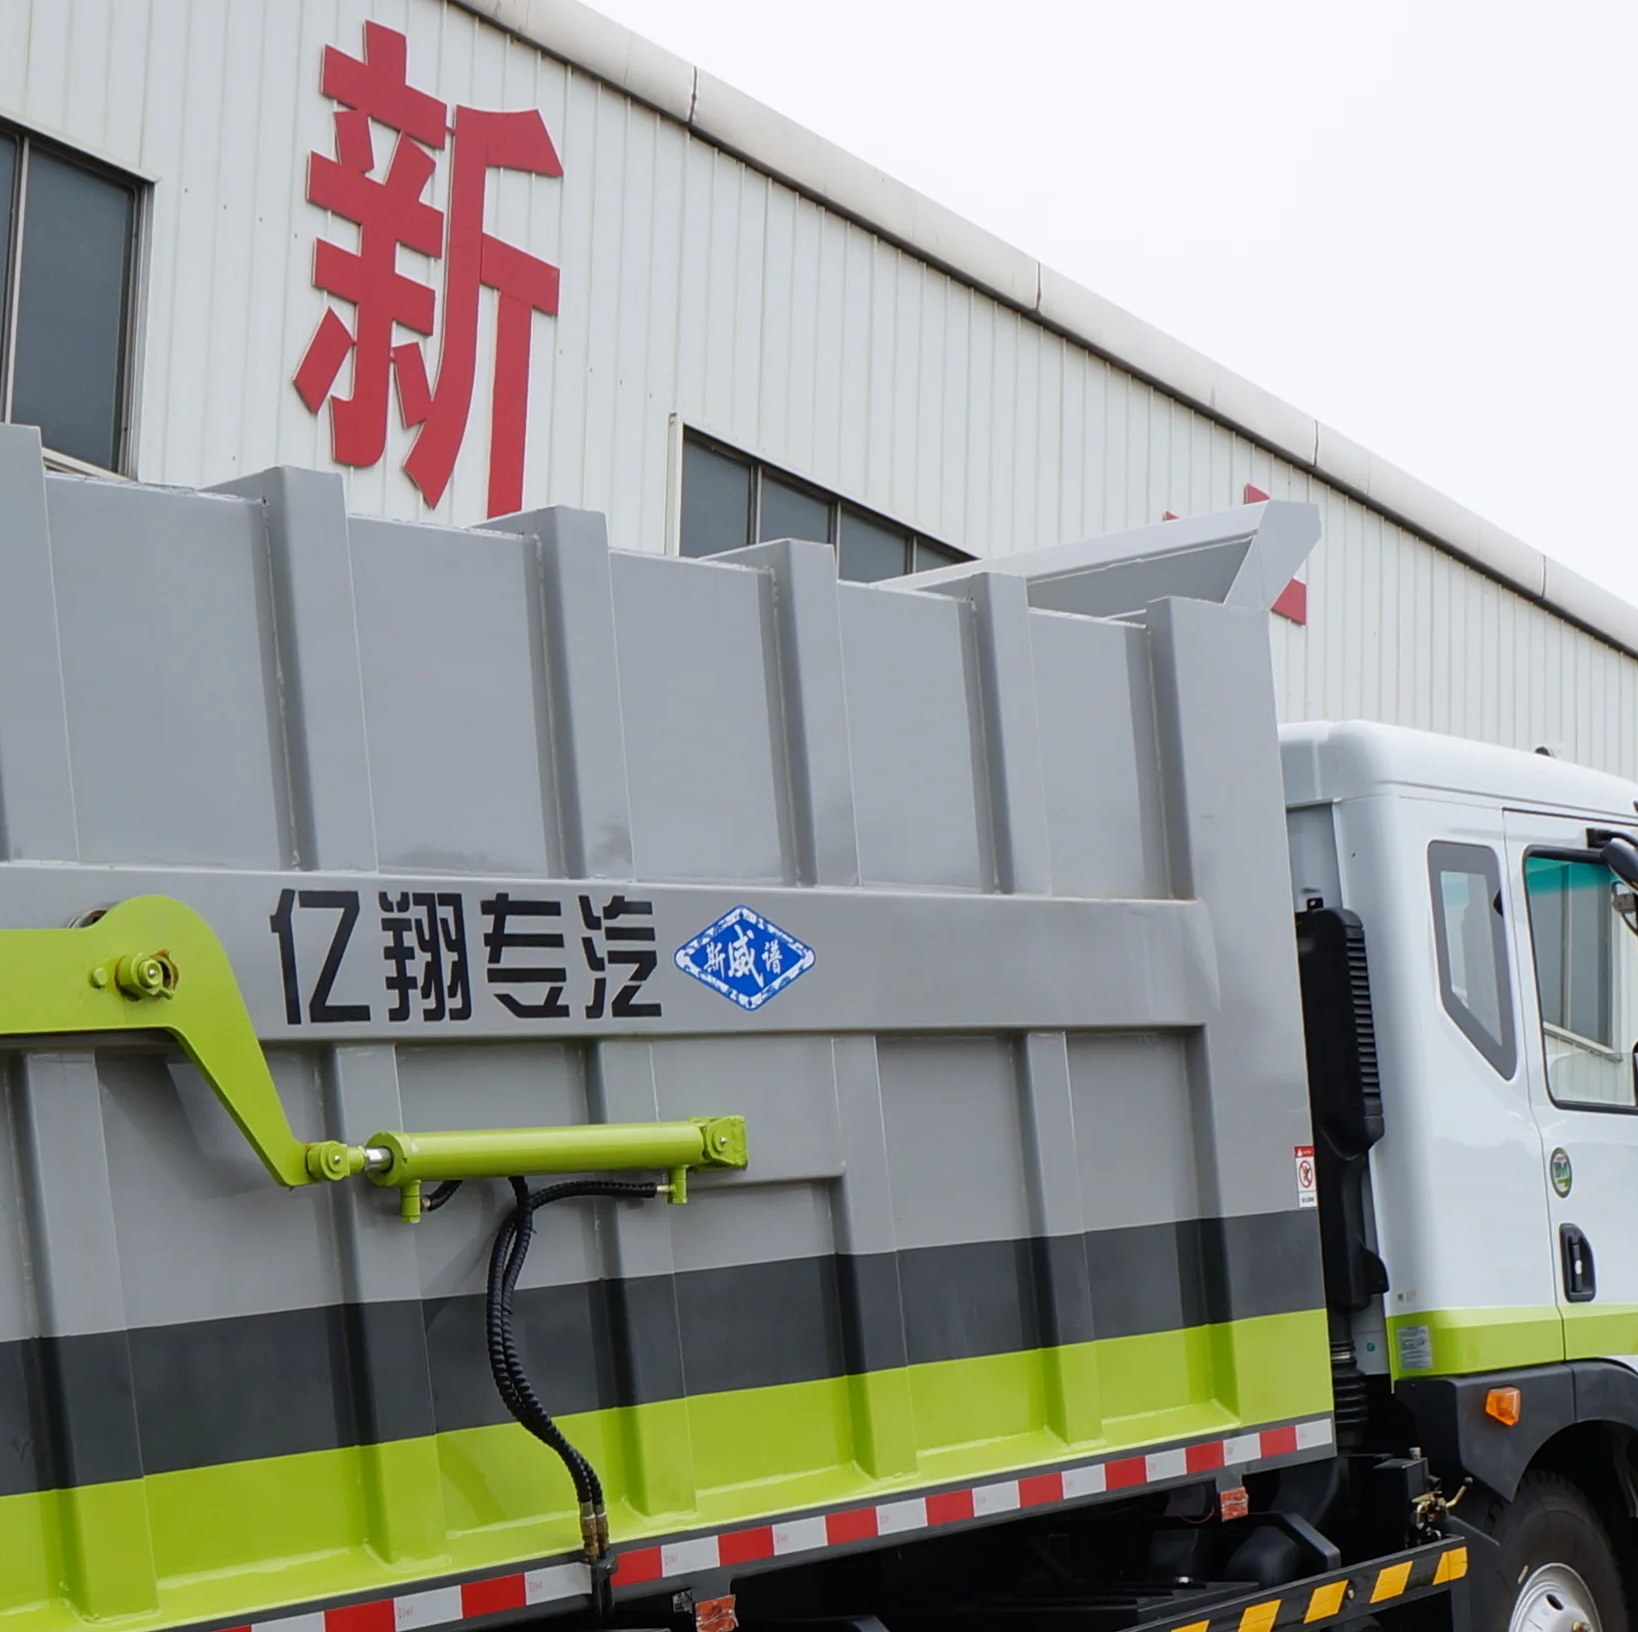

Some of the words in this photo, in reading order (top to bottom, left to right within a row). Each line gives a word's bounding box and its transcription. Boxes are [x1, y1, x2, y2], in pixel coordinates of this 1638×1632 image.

[292, 20, 564, 519] 新
[269, 888, 663, 1025] 亿翔专汽
[703, 924, 783, 989] 斯威谱
